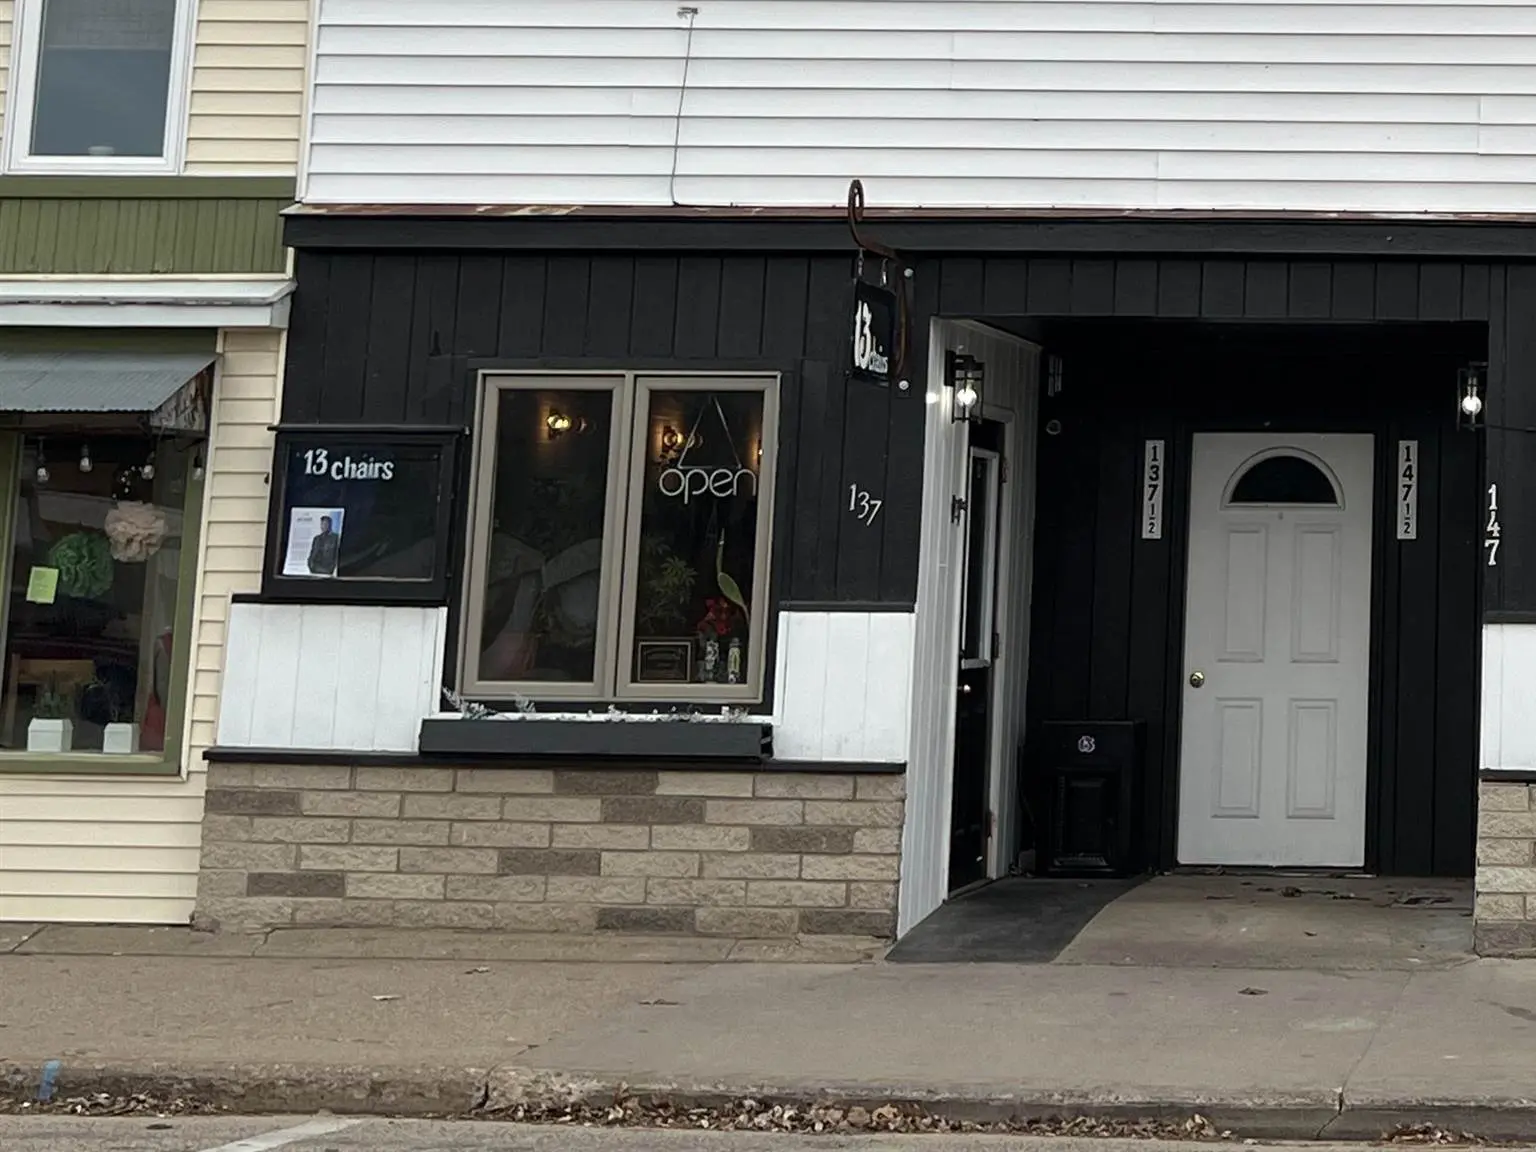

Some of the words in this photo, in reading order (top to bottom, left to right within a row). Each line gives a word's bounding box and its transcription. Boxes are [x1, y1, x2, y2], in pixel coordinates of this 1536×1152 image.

[854, 299, 872, 370] 13
[303, 448, 329, 475] 13
[331, 456, 394, 480] chairs
[659, 468, 757, 504] open
[1147, 445, 1160, 501] 137
[1402, 445, 1414, 501] 147
[849, 483, 882, 526] 137
[1484, 483, 1501, 566] 147
